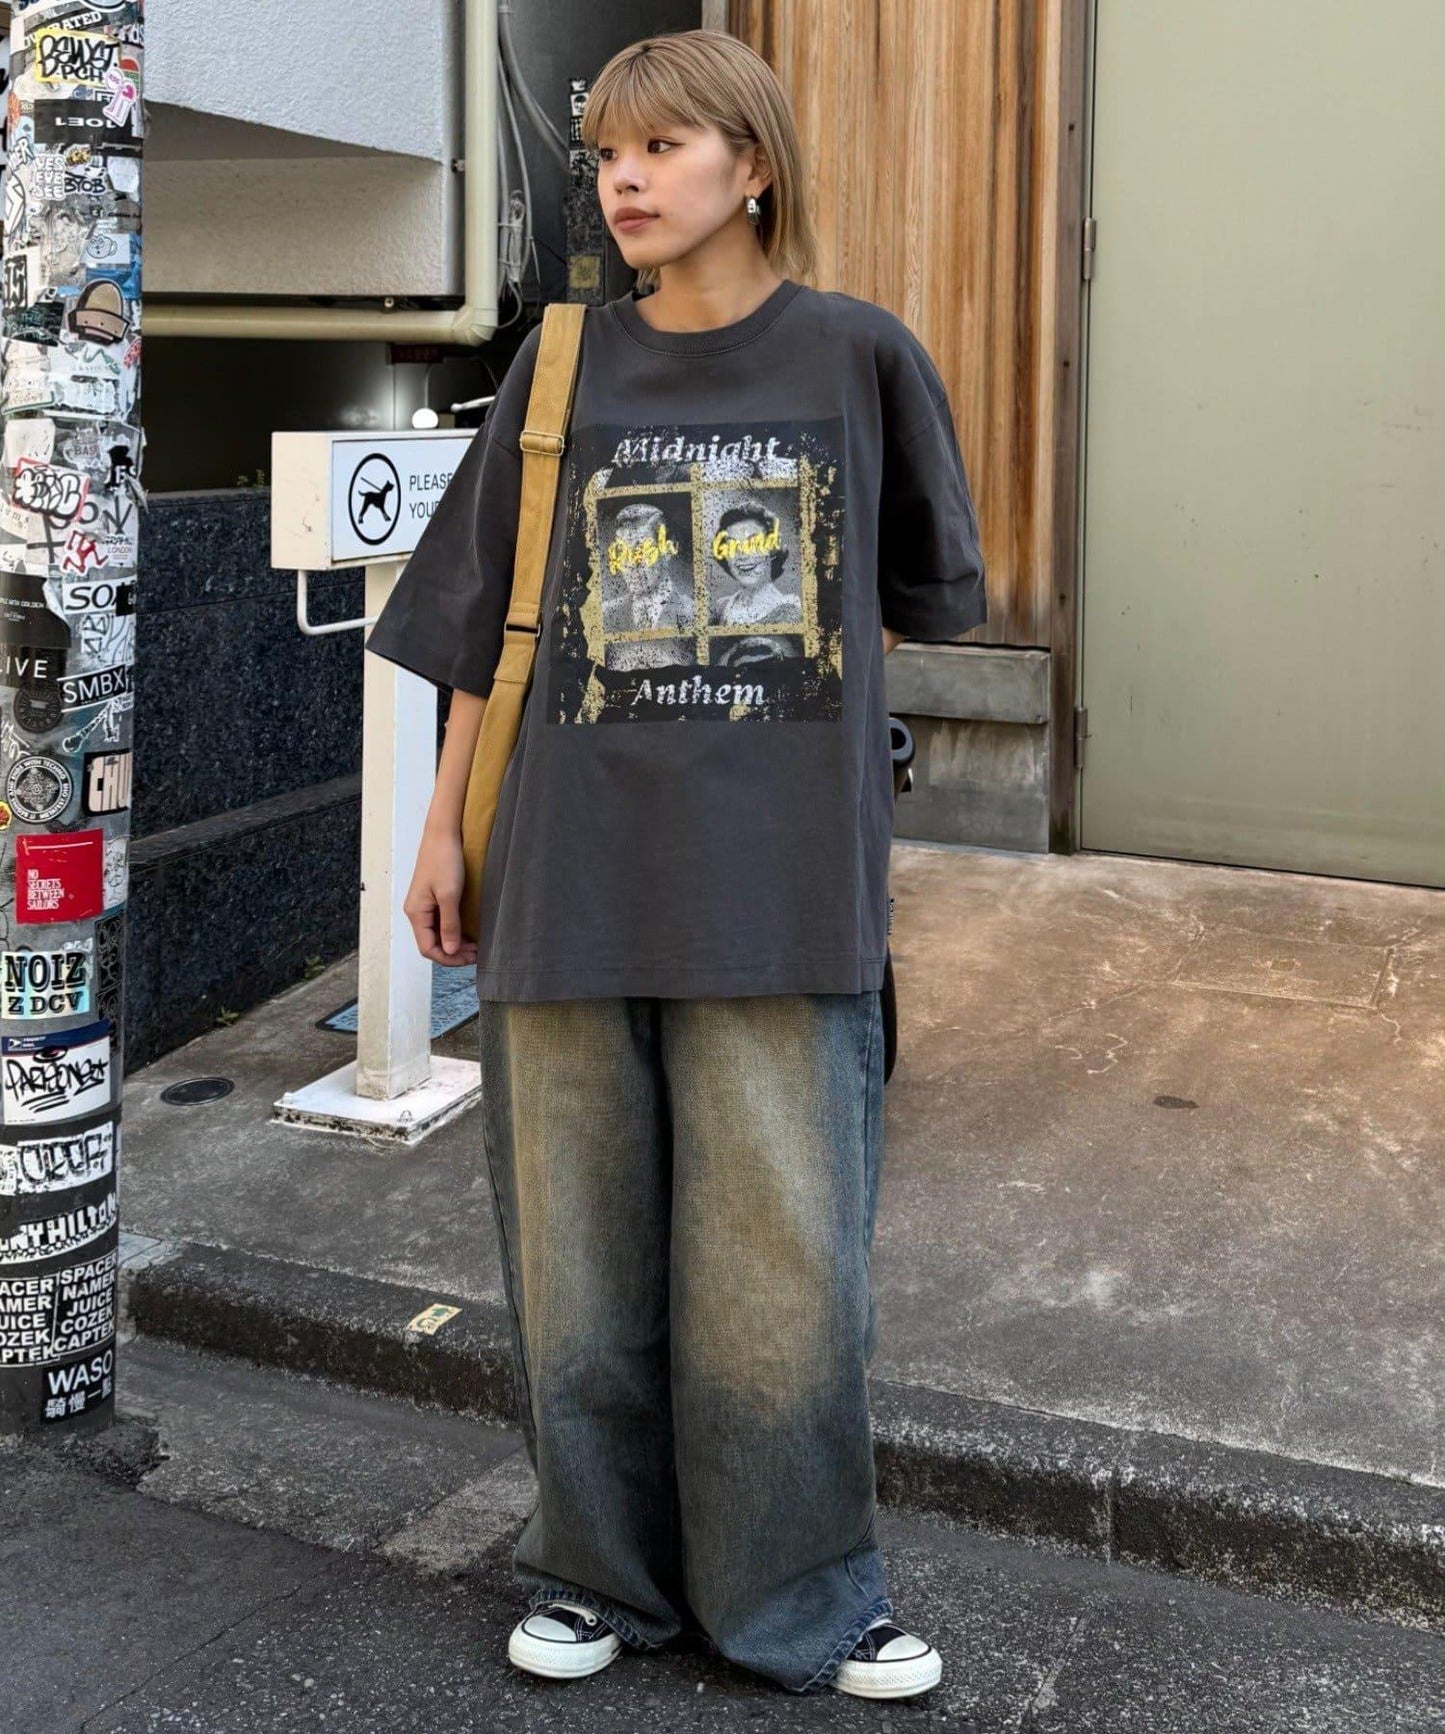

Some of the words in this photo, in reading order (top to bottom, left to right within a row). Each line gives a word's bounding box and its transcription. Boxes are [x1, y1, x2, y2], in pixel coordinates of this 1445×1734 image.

[611, 434, 781, 464] Midnight
[62, 668, 126, 703] SMBX
[631, 674, 766, 706] Anthem
[4, 952, 87, 993] NOIZ
[66, 1287, 112, 1316] JUICE
[48, 1349, 113, 1396] WASO
